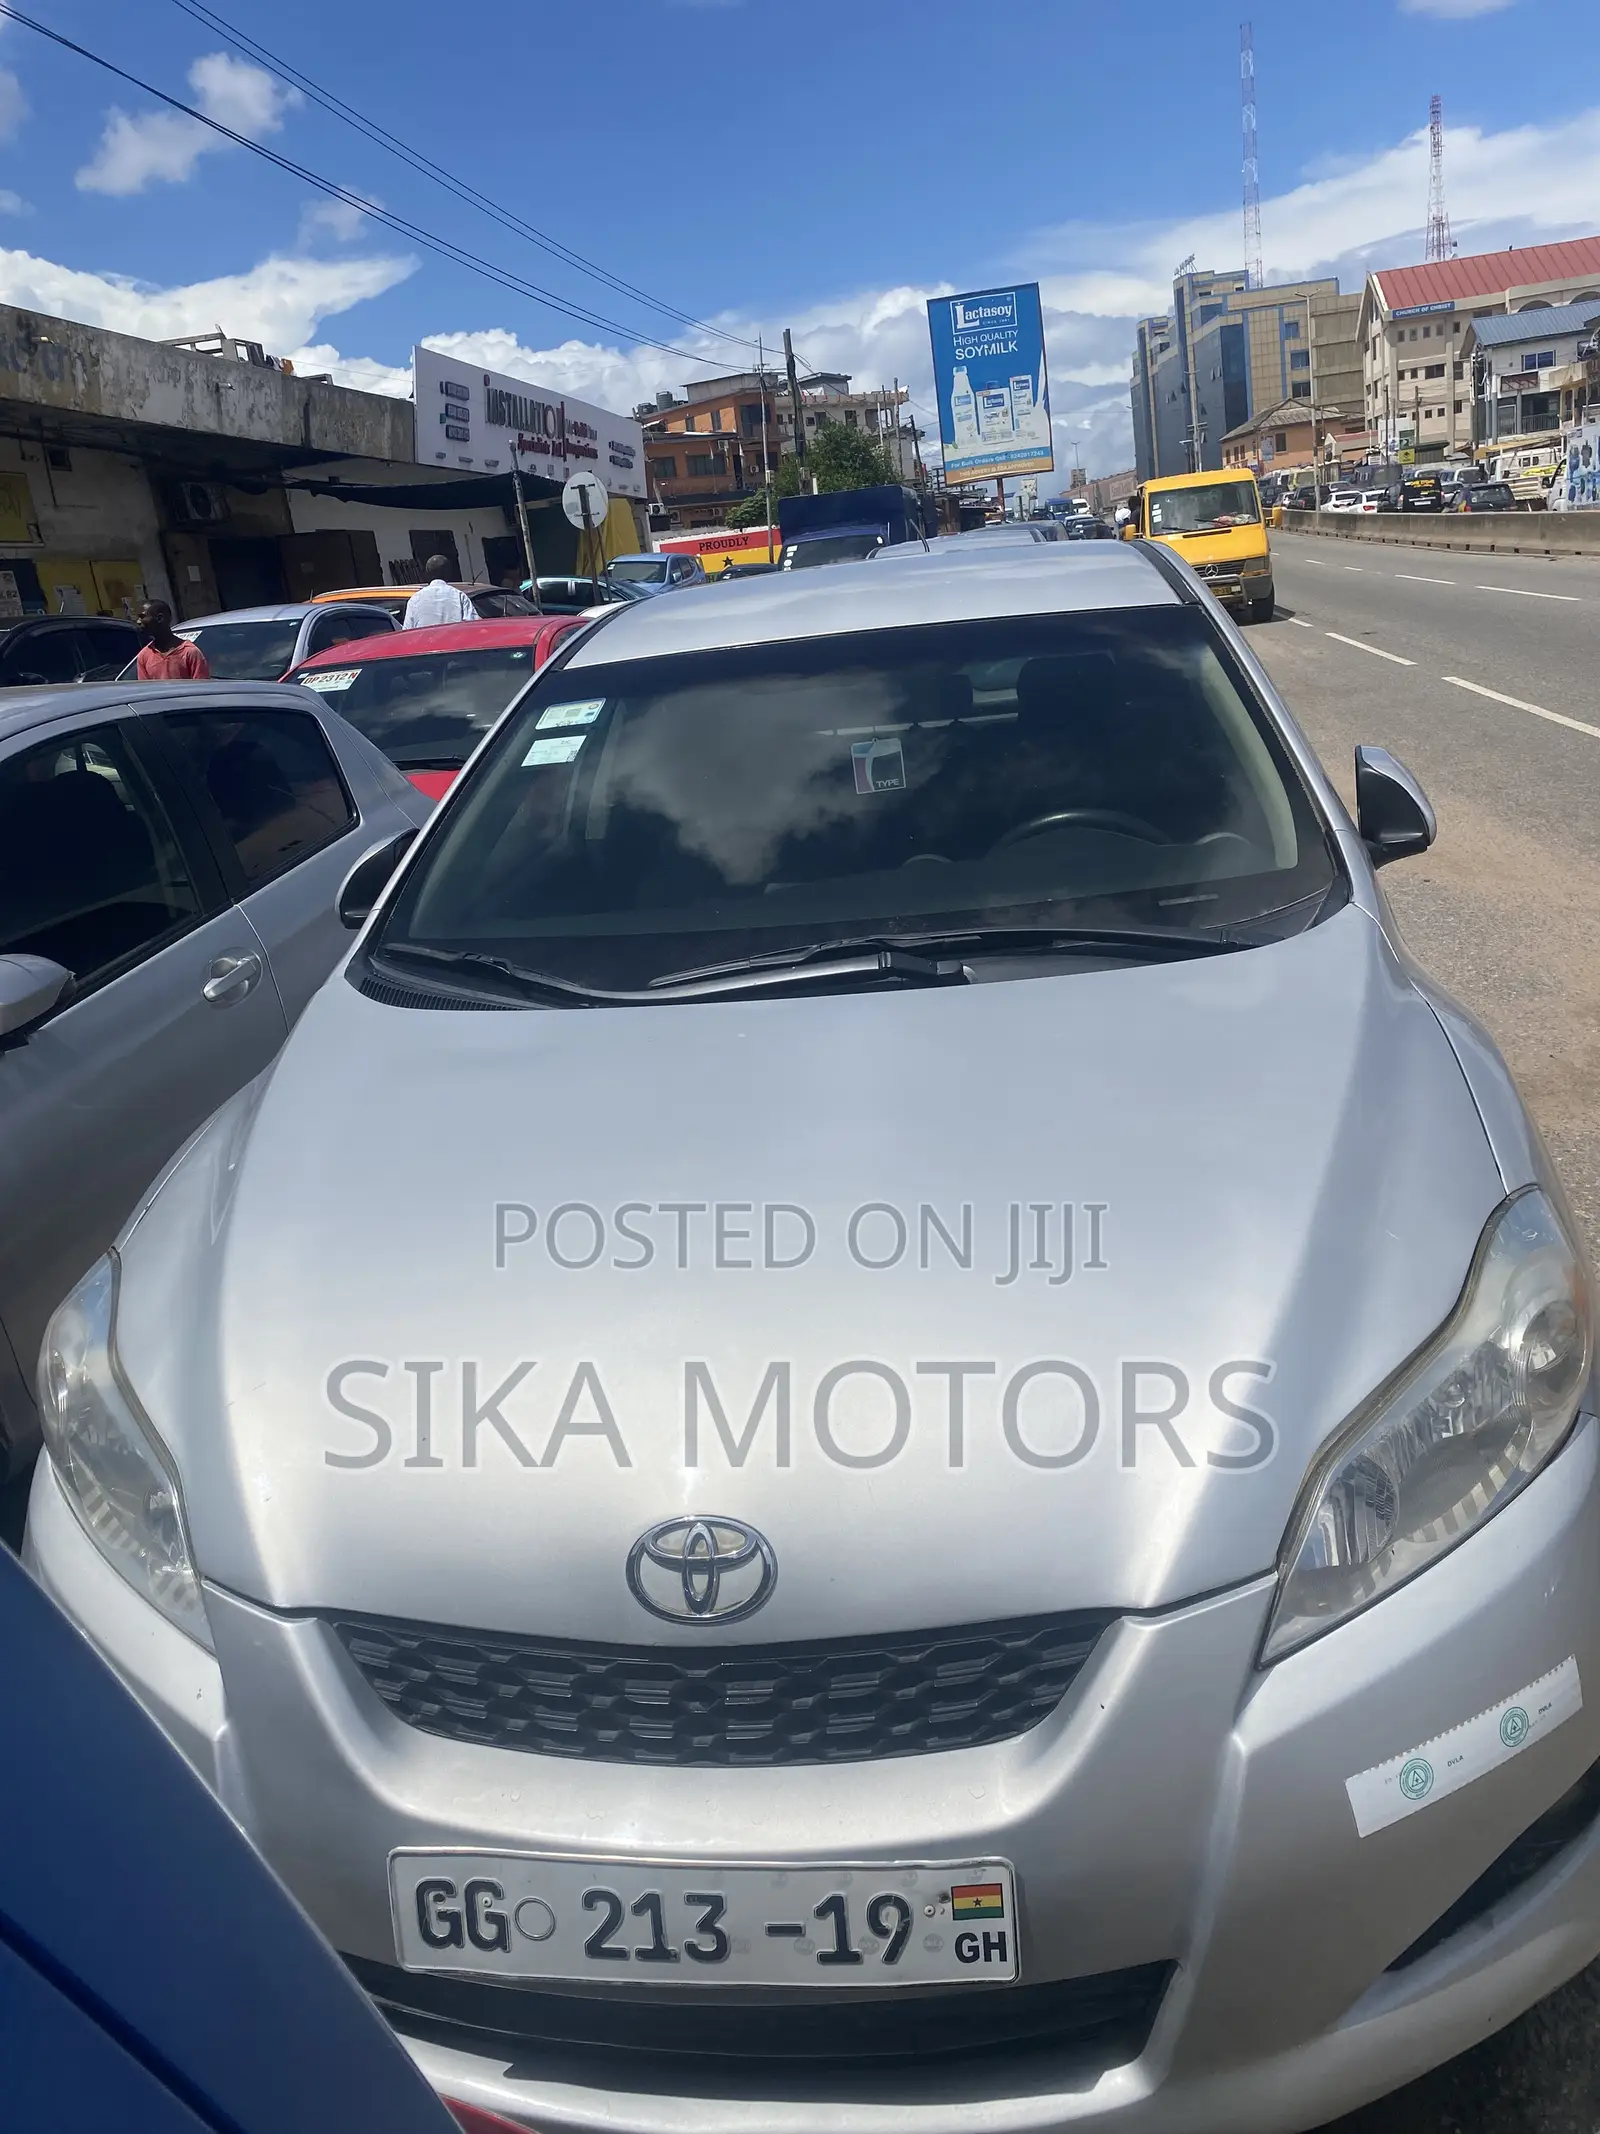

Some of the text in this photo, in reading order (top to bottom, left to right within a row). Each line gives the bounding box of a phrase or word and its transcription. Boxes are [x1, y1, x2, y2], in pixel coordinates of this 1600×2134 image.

[955, 303, 1012, 329] Lactasoy
[1396, 308, 1420, 316] CHURCH
[953, 330, 1019, 347] HIGH QUALITY
[955, 340, 1018, 360] SOYMILK
[699, 536, 749, 552] PROUDLY
[876, 778, 900, 788] TYPE
[1447, 1755, 1464, 1767] DVLA
[415, 1877, 511, 1953] GG
[581, 1888, 731, 1964] 213
[954, 1931, 1008, 1964] GH
